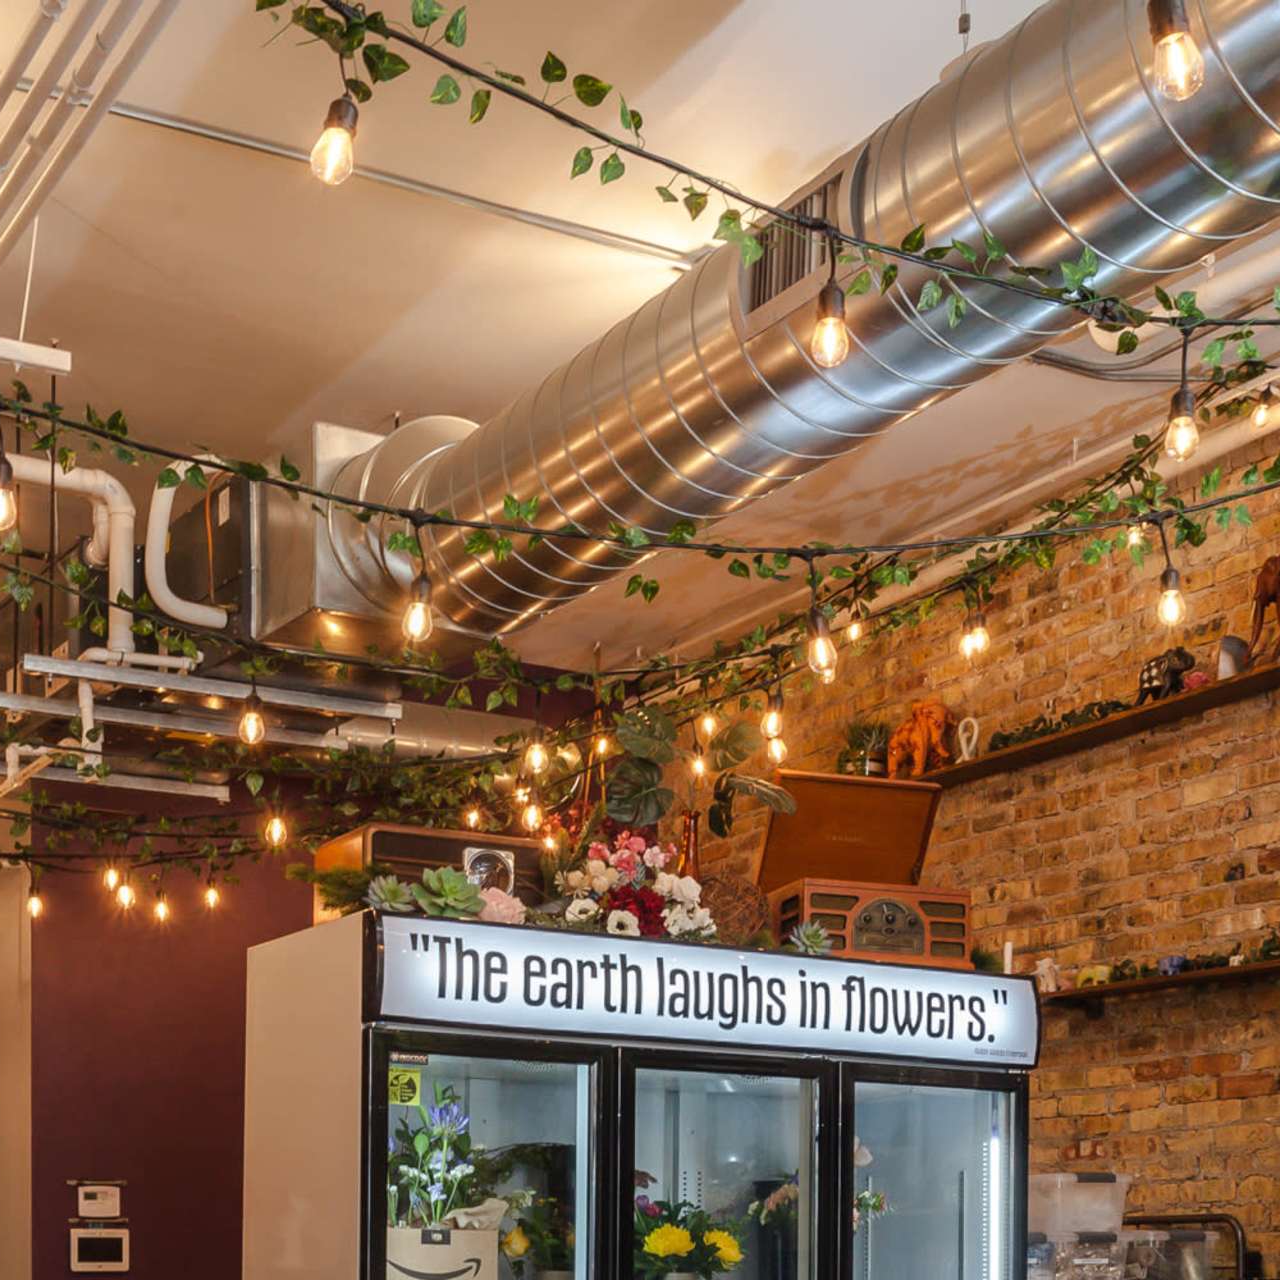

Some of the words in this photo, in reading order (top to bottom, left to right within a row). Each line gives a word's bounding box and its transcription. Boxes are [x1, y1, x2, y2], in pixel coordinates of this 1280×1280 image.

[410, 932, 508, 1004] "The
[523, 953, 642, 1014] earth
[657, 957, 787, 1030] laughs
[798, 969, 831, 1029] in
[842, 974, 1008, 1043] flowers."
